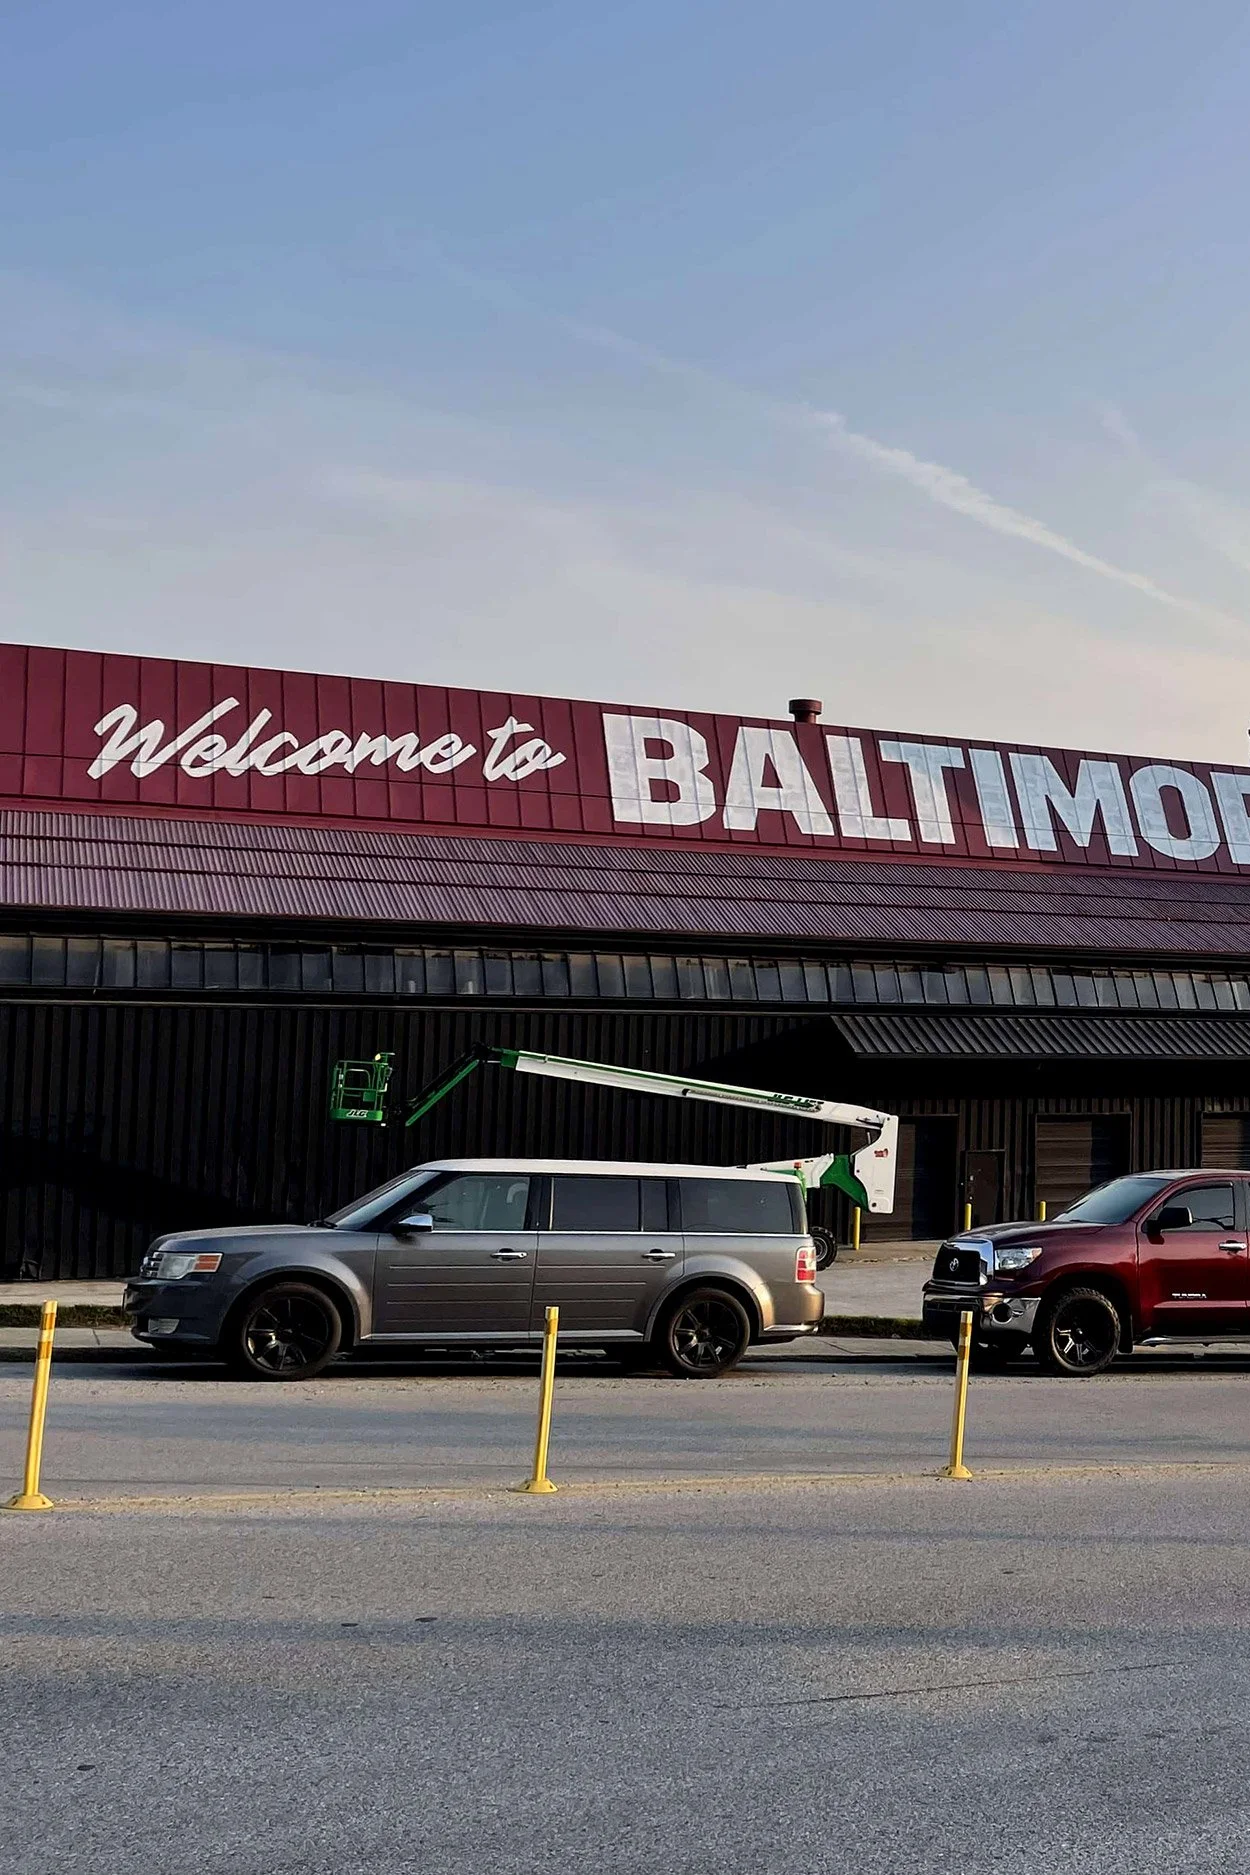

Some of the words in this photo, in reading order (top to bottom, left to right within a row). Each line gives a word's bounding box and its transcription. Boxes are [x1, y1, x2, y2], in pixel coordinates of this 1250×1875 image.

[86, 697, 477, 780] Welcome
[482, 715, 567, 783] to
[346, 1109, 368, 1118] JLG
